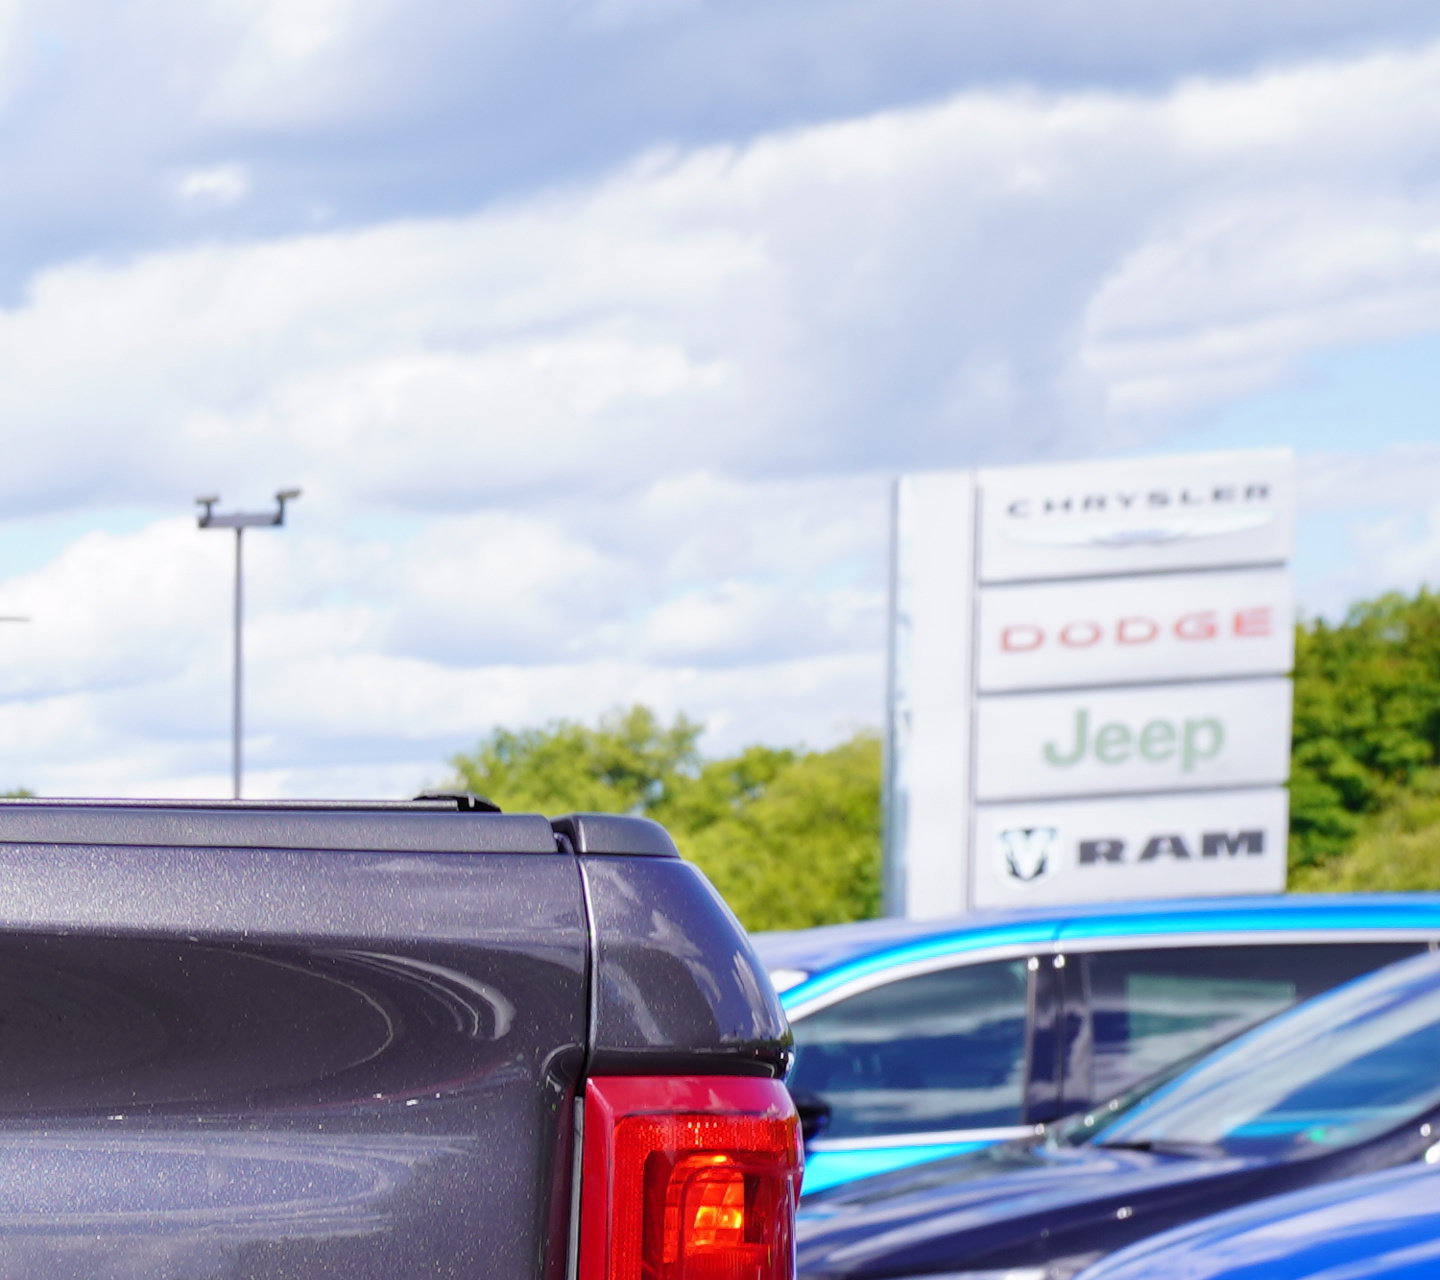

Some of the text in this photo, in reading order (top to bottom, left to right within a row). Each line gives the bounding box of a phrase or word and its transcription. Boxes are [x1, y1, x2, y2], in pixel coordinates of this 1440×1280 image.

[1007, 484, 1272, 519] CHRYSLER
[1000, 607, 1274, 653] DODGE
[1043, 708, 1226, 772] Jeep
[1077, 828, 1267, 867] RAM
